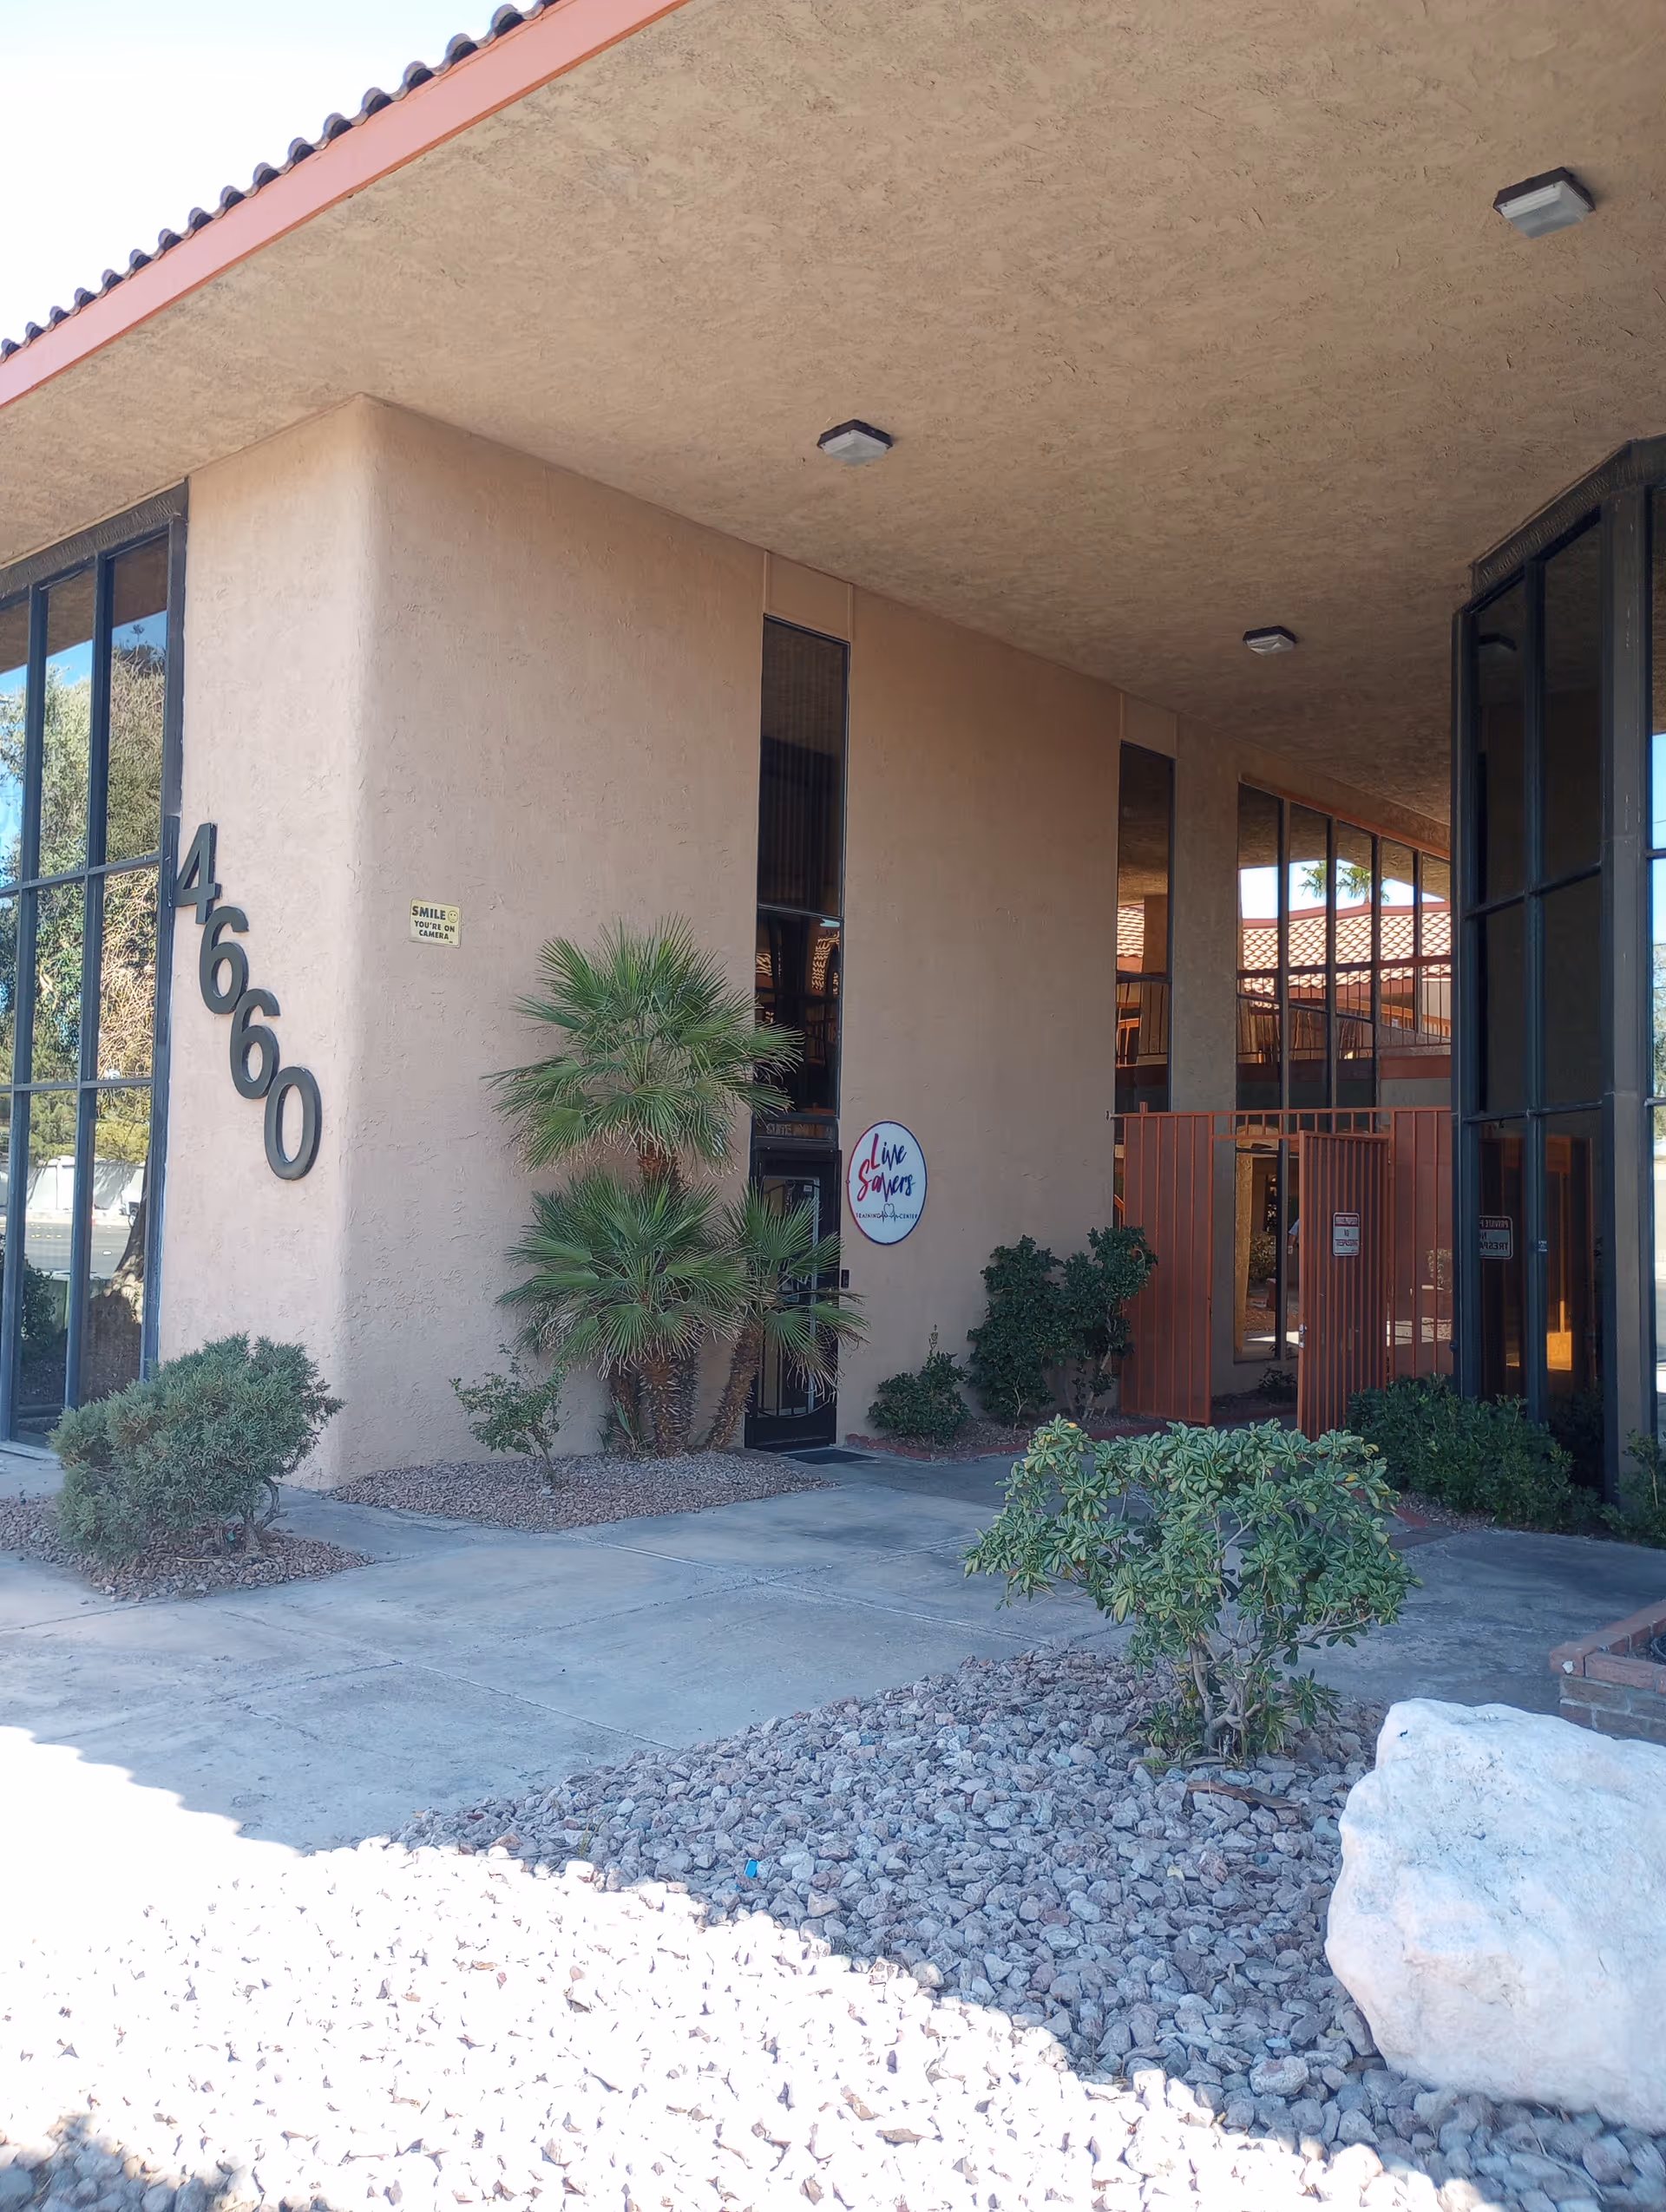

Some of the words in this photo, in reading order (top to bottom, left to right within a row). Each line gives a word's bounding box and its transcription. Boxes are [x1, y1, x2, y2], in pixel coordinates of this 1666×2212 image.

[411, 905, 446, 920] SMILE
[414, 919, 442, 931] YOU'RE
[418, 929, 449, 939] CAMERA
[174, 822, 322, 1181] 4660
[870, 1133, 907, 1171] Live
[856, 1158, 916, 1202] Savers
